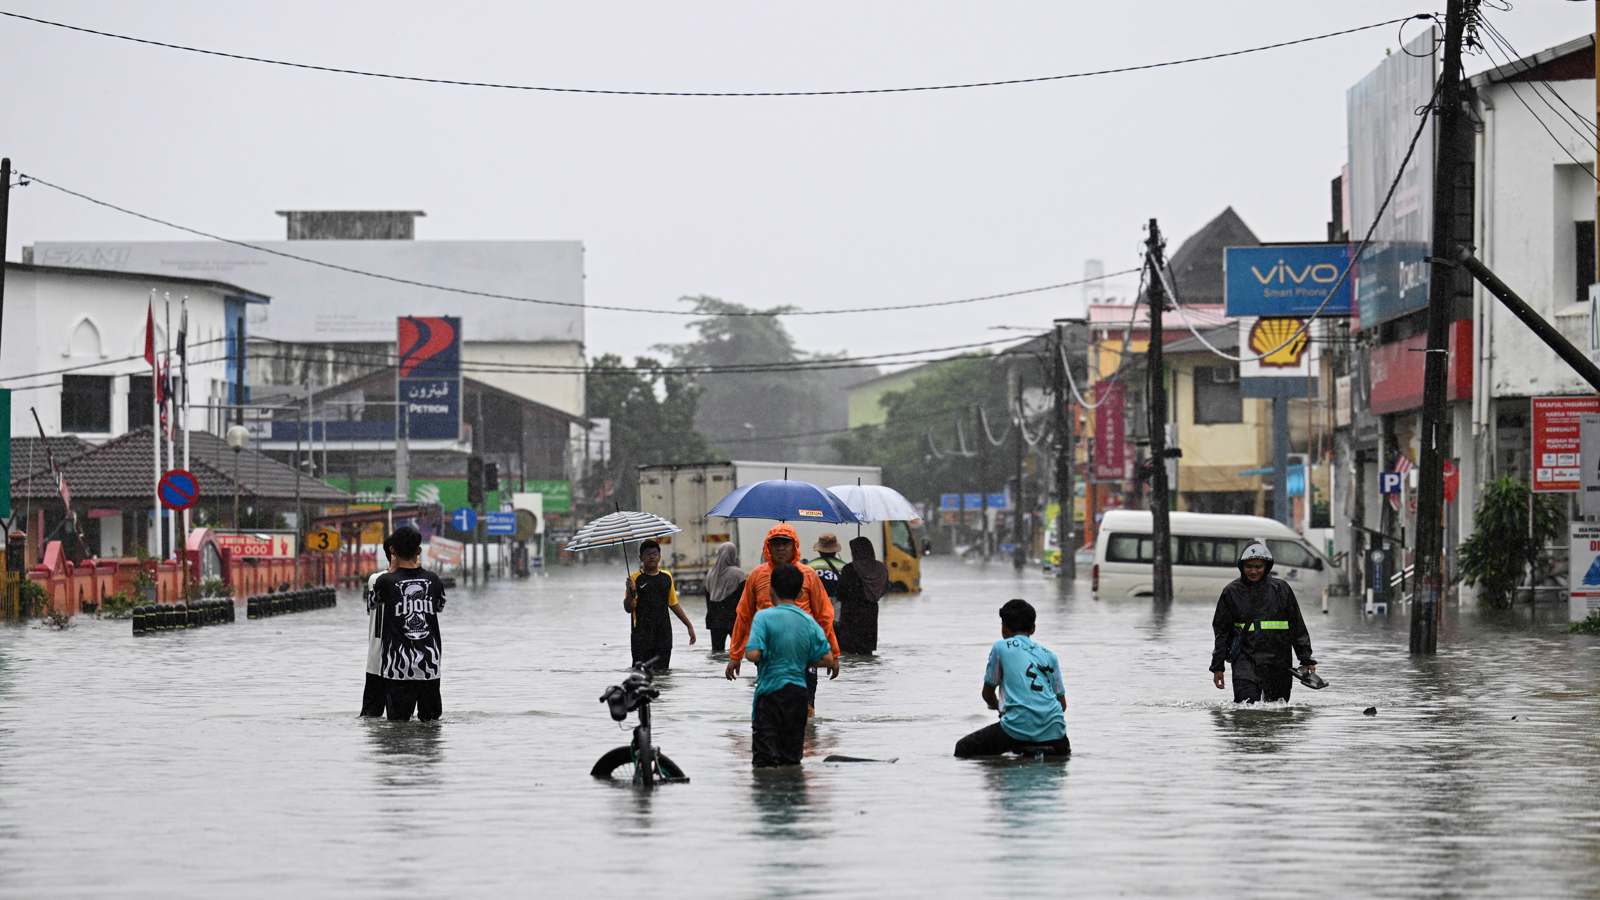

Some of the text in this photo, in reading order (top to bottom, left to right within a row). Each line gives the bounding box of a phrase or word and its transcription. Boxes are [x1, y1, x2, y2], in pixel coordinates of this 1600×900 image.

[1251, 259, 1338, 284] vivo
[1263, 288, 1293, 298] Smart
[1384, 475, 1399, 492] P
[317, 533, 330, 550] 3
[1006, 640, 1020, 648] FC
